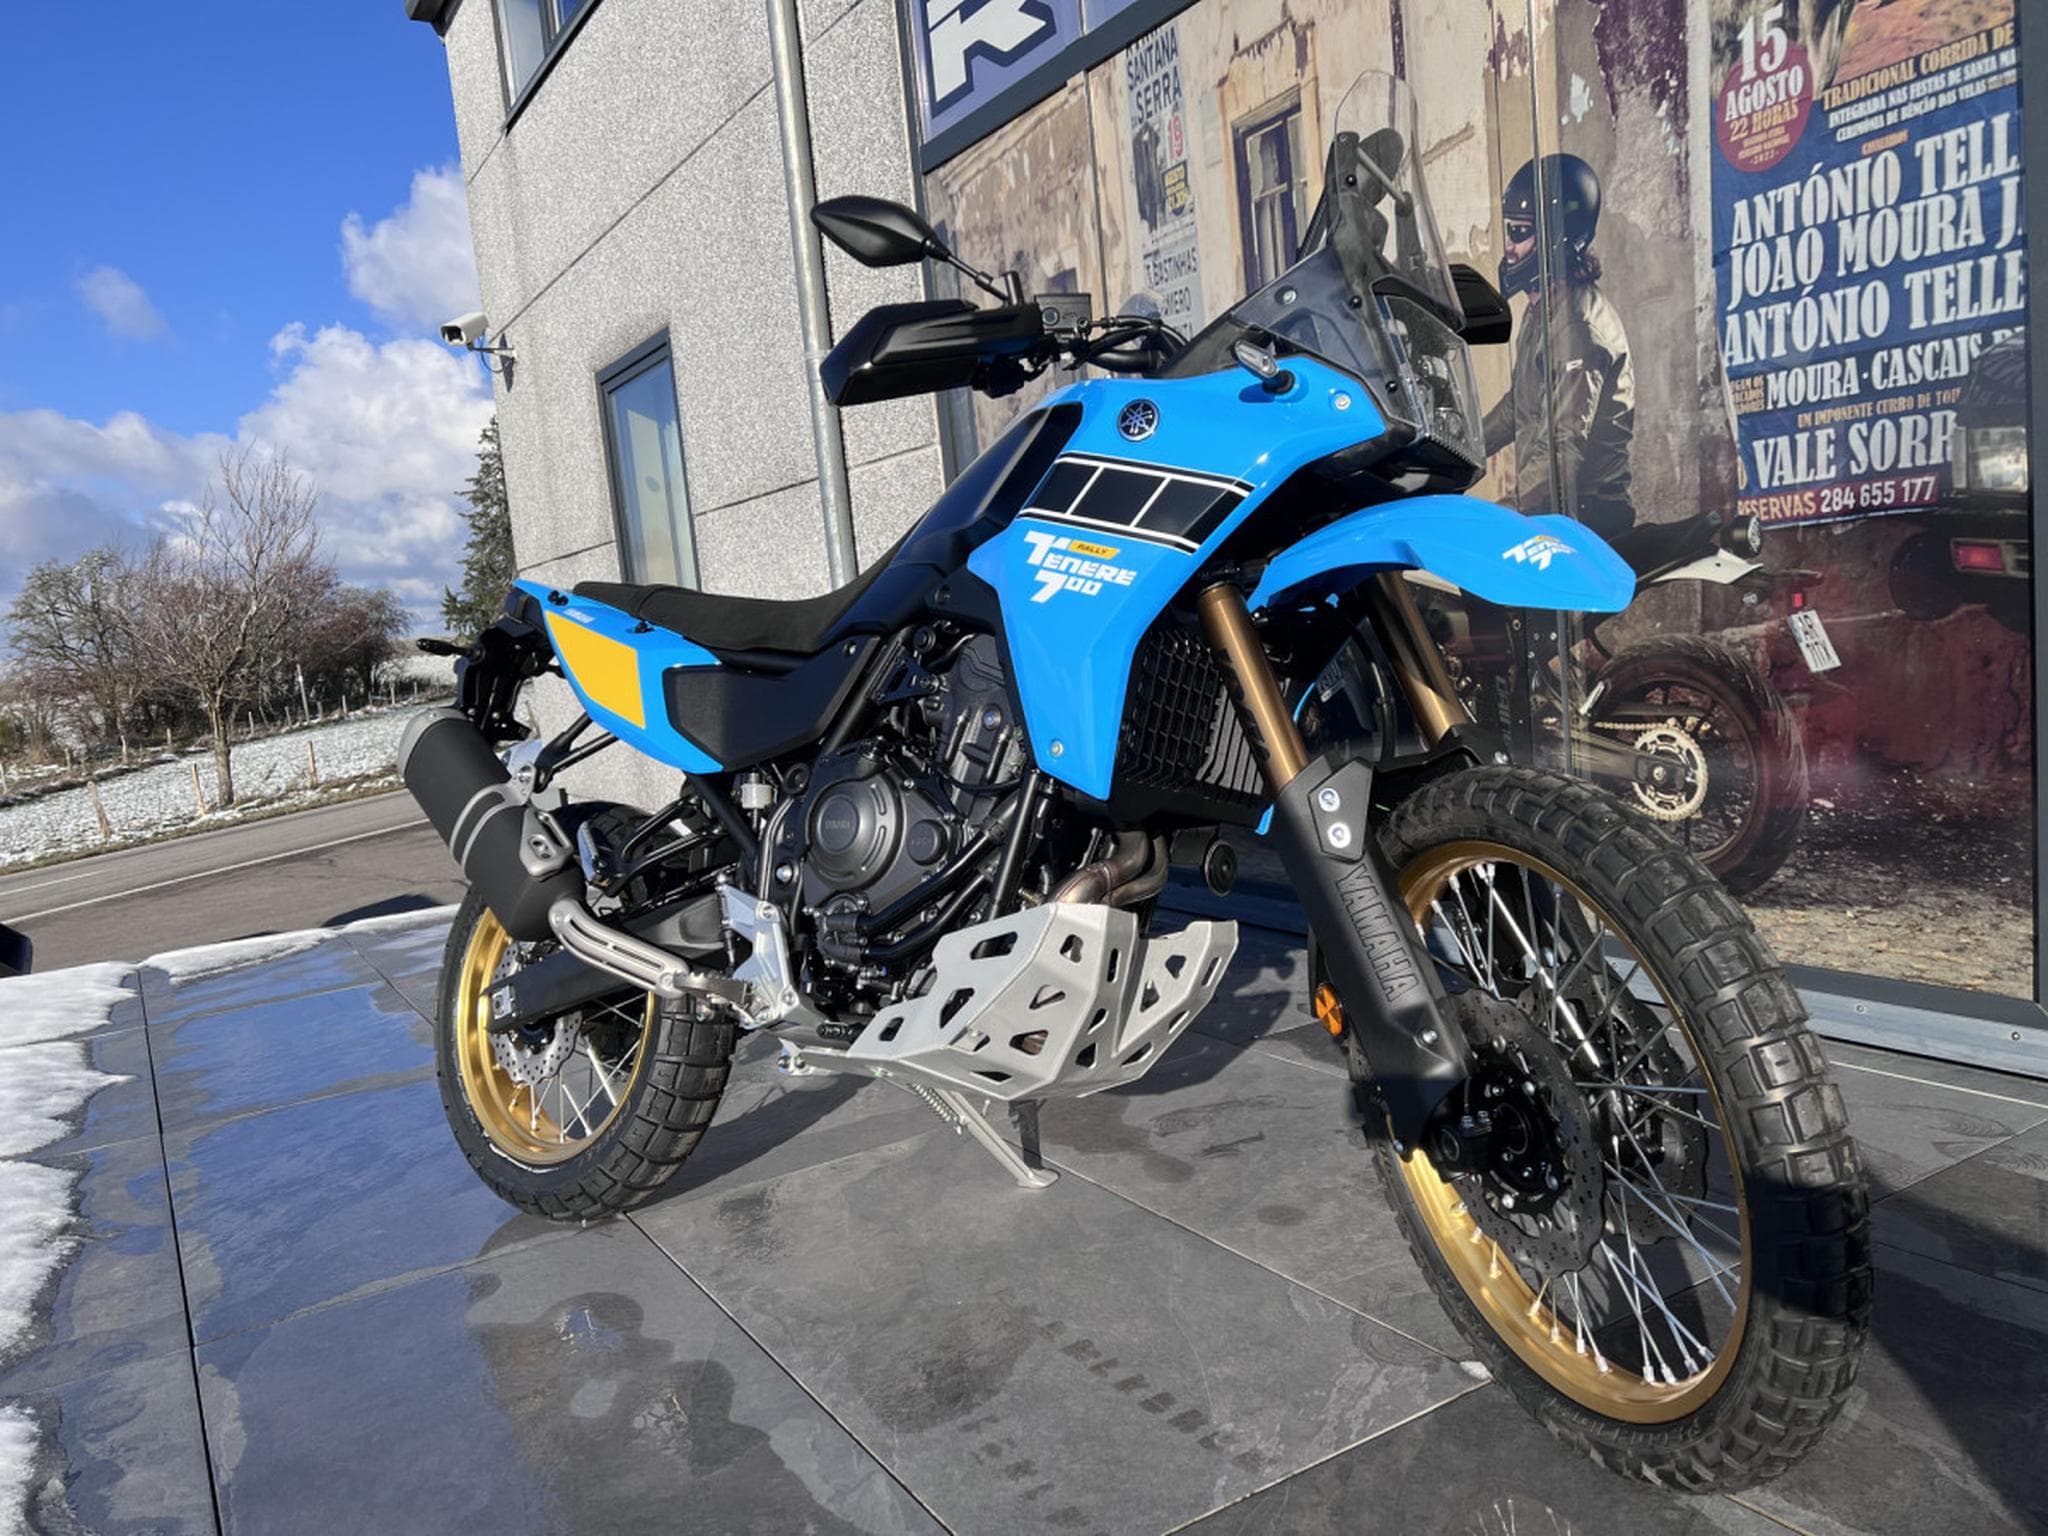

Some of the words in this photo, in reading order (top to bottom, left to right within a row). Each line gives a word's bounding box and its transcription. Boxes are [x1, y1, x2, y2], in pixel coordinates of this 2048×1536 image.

[1127, 26, 1178, 91] SANTANA
[1737, 6, 1788, 82] 15
[1823, 58, 1918, 111] TRADICIONAL
[1920, 33, 1988, 74] CORRIDA
[1993, 23, 2014, 49] DE
[1136, 66, 1182, 125] SERRA
[1725, 65, 1804, 122] AGOSTO
[1730, 117, 1749, 142] 22
[1751, 98, 1799, 134] HORAS
[1732, 151, 1901, 247] ANTÓNIO
[1837, 186, 1985, 278] MOURA
[1996, 176, 2023, 249] J
[1725, 280, 1890, 368] ANTÓNIO
[1904, 250, 2025, 329] TELLE
[1767, 358, 1859, 410] MOURA
[1815, 402, 1873, 425] IMPONENTE
[1752, 428, 1836, 489] VALE
[1820, 486, 1856, 514] 284
[1860, 481, 1895, 507] 655
[1902, 476, 1936, 503] 177
[1077, 543, 1109, 556] RALLY
[1030, 569, 1102, 603] 700
[1336, 864, 1419, 1005] YAMAHA
